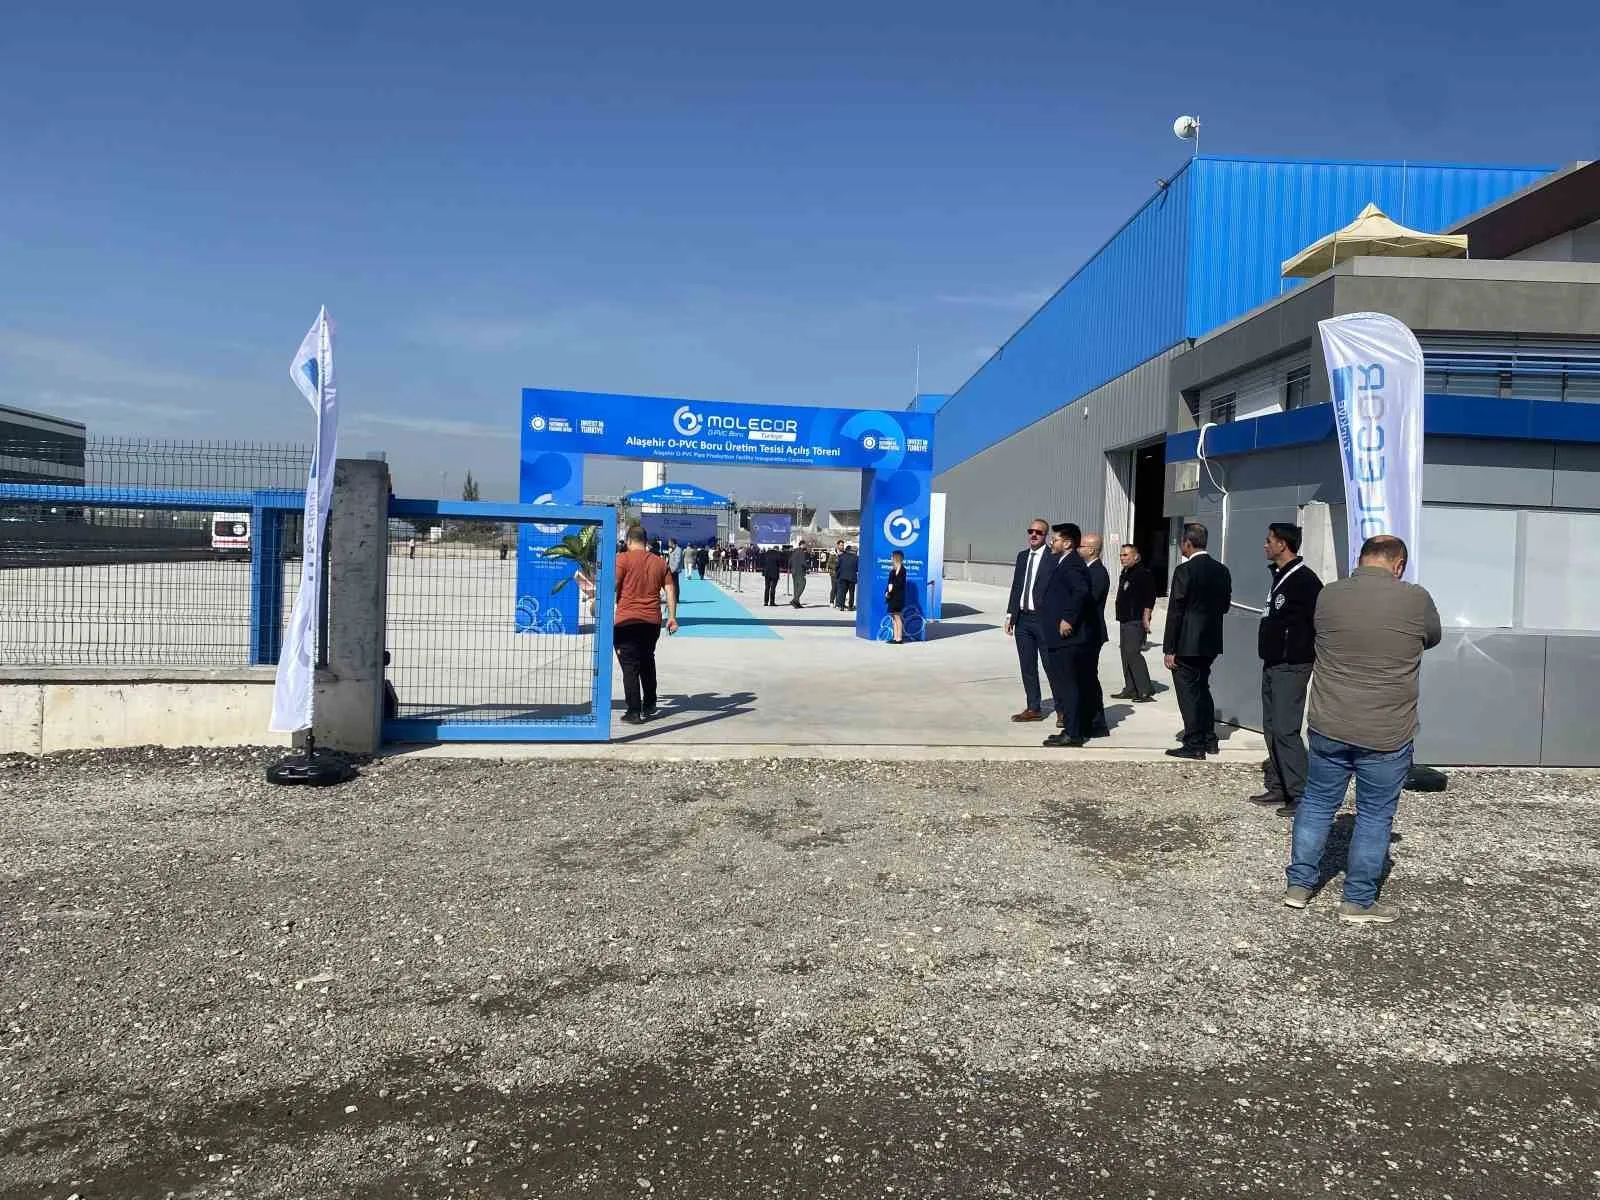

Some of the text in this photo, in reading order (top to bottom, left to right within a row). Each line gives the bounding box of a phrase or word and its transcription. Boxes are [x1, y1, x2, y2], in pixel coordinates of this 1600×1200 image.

[707, 415, 798, 432] MOLECOR
[625, 436, 840, 457] Alaşehir O-PVC Boru Üretim Tesisi Açılış Töreni
